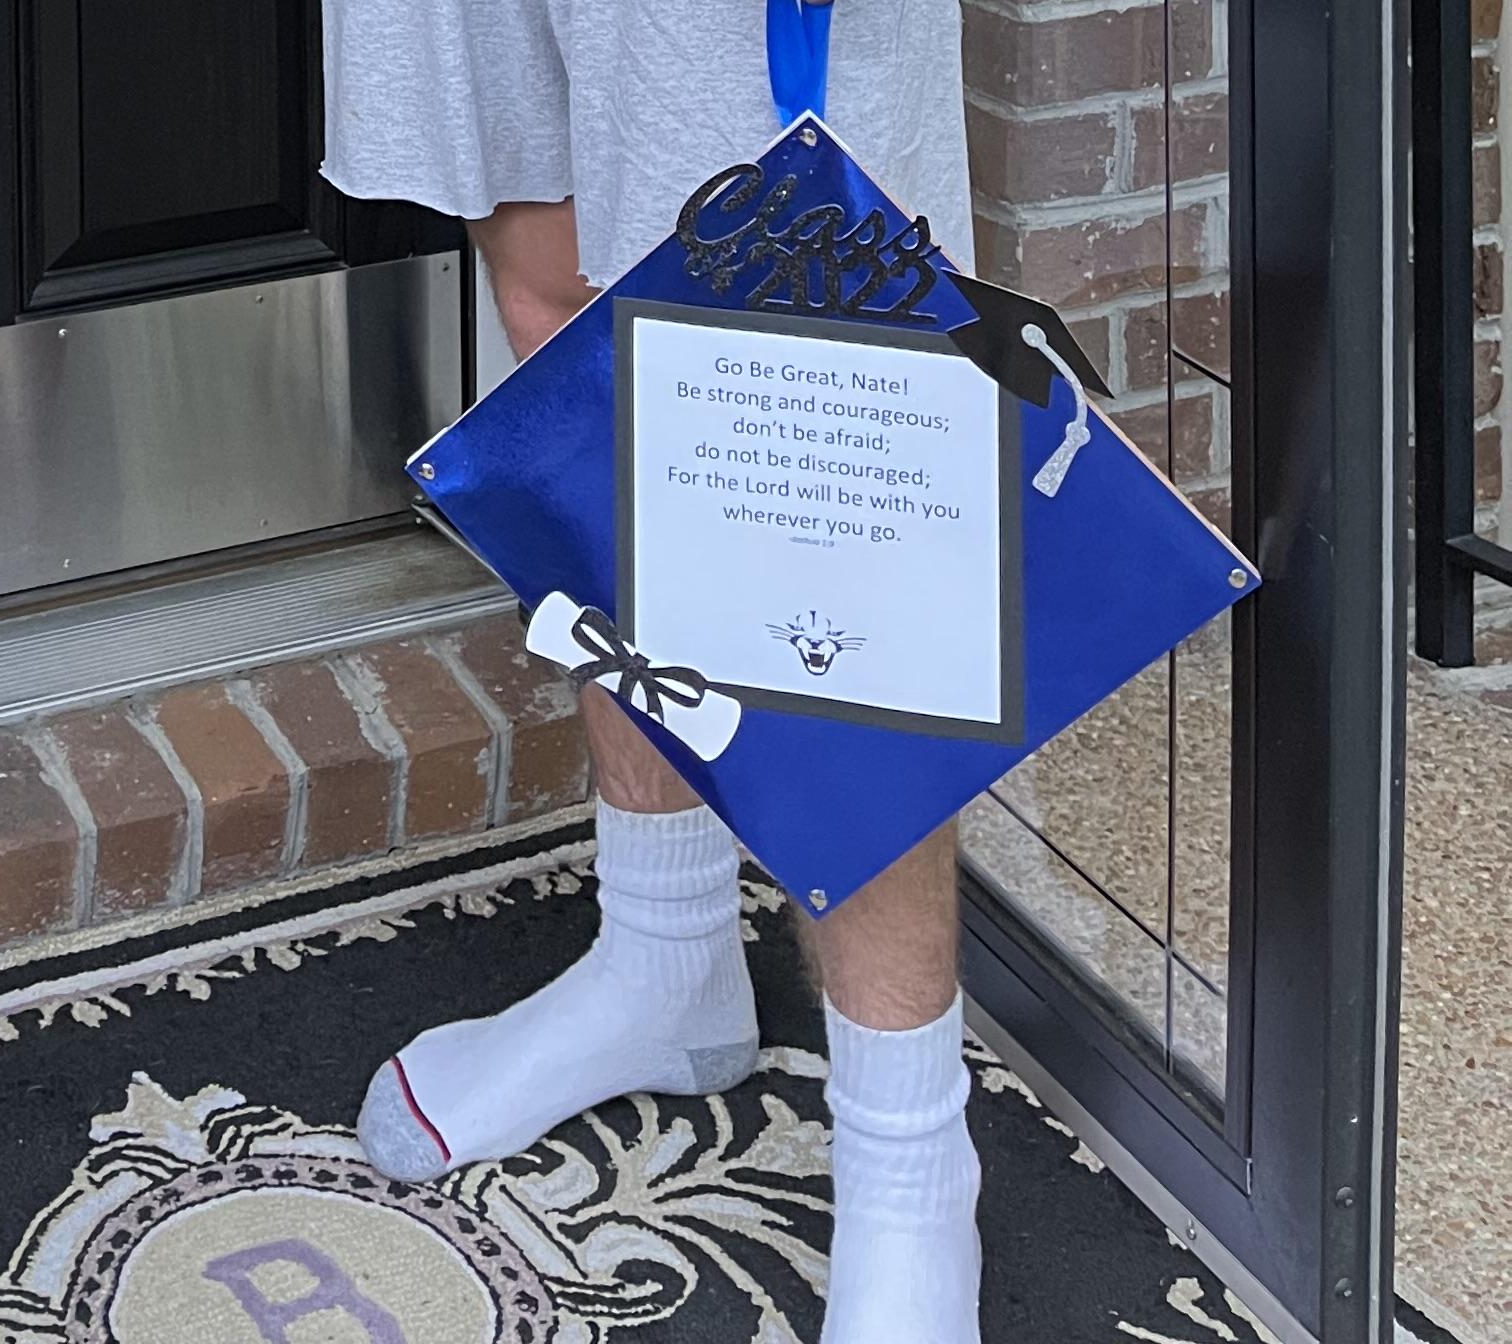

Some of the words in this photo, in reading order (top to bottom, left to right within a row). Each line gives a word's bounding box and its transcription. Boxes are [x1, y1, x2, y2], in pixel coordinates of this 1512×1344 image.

[675, 162, 942, 264] Class
[745, 244, 938, 324] 2022
[715, 357, 743, 375] Go
[750, 360, 775, 380] Be
[780, 363, 845, 390] Great,
[852, 372, 909, 396] Nate!
[677, 381, 702, 399] Be
[707, 386, 772, 411] strong
[777, 395, 816, 413] and
[821, 402, 951, 433] courageous;
[793, 423, 818, 442] be
[824, 428, 891, 455] afraid;
[695, 441, 720, 460] do
[727, 448, 761, 465] not
[767, 449, 792, 468] be
[798, 453, 931, 489] discouraged;
[668, 466, 700, 486] For
[706, 471, 739, 491] the
[745, 476, 789, 497] Lord
[797, 484, 831, 502] will
[838, 487, 863, 507] be
[869, 492, 915, 514] with
[921, 502, 961, 520] you
[723, 504, 821, 530] wherever
[826, 518, 864, 537] you
[870, 526, 902, 543] go.
